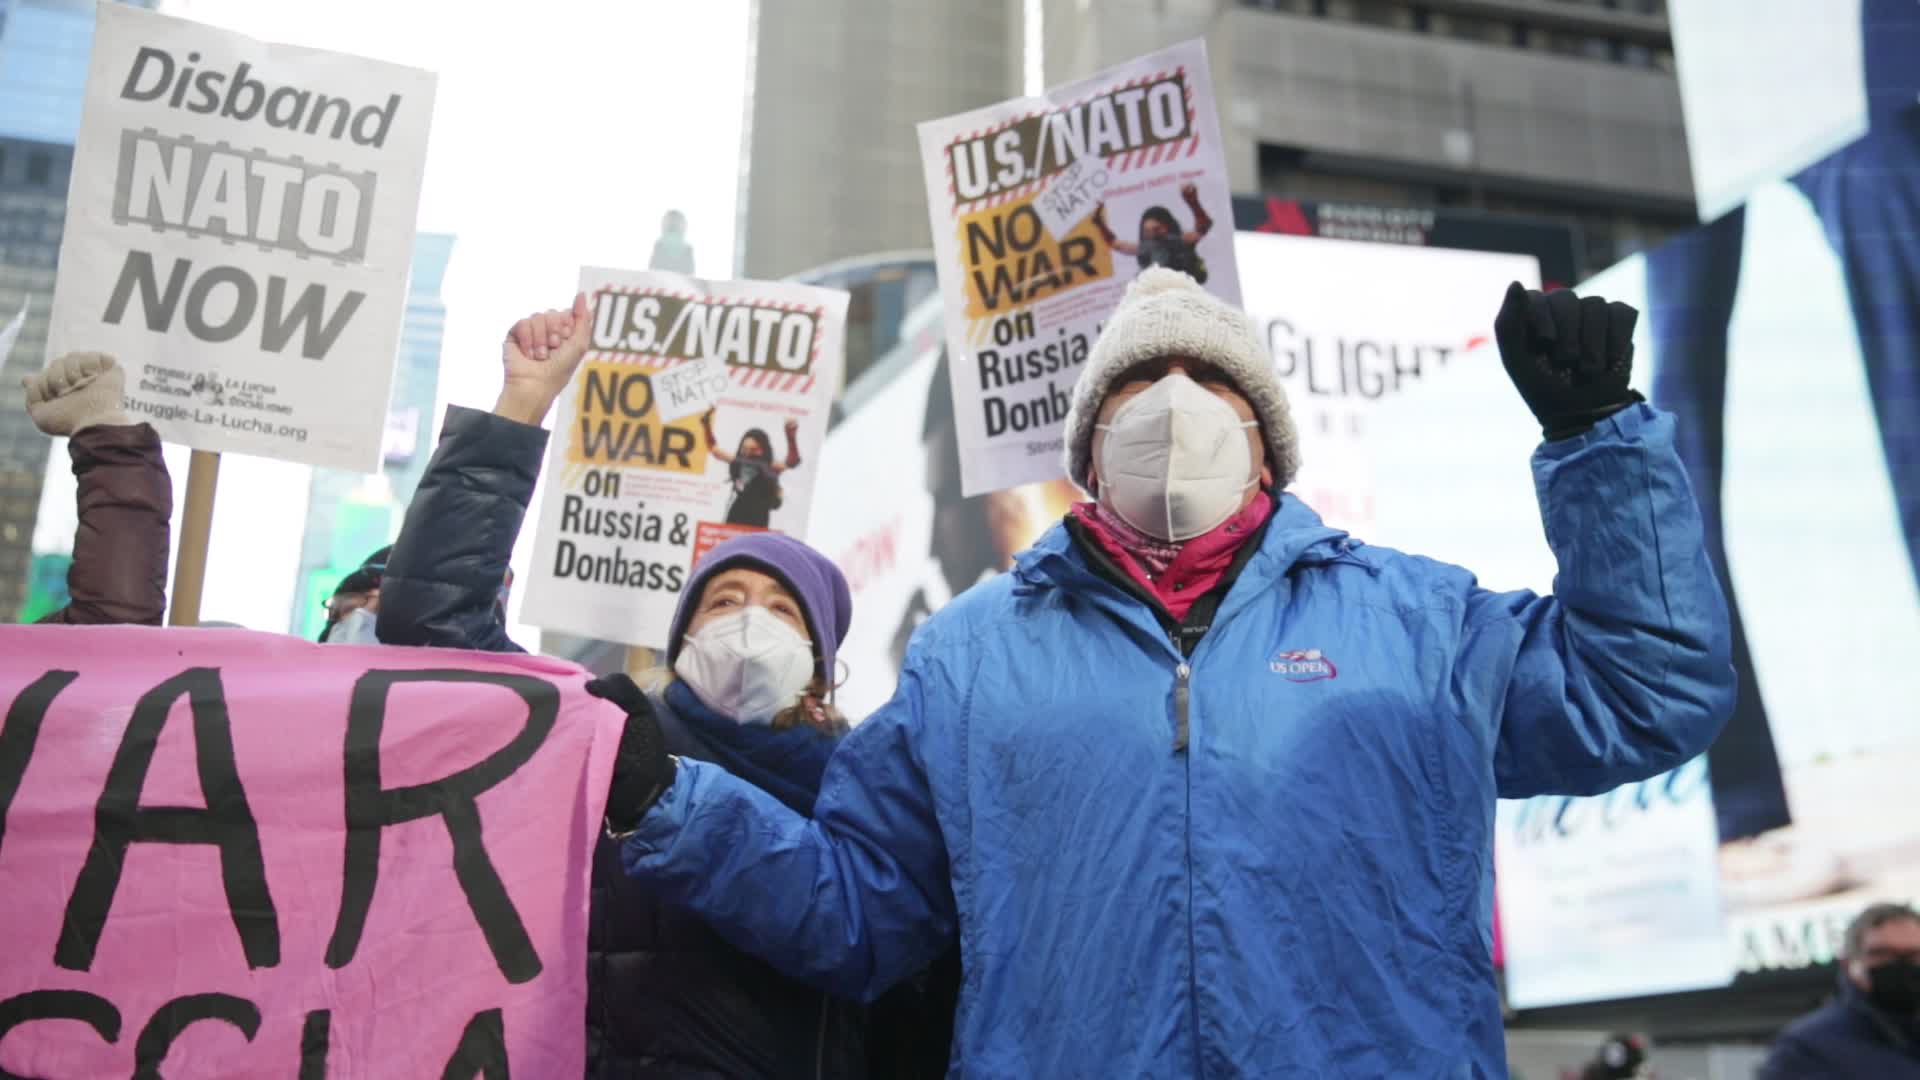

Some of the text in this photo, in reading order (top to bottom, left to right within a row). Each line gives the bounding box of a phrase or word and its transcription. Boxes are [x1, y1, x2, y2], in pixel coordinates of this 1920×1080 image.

[120, 47, 402, 149] Disband
[127, 137, 361, 255] NATO
[966, 203, 1043, 265] NO
[103, 249, 366, 361] NOW
[969, 236, 1098, 312] WAR
[978, 326, 1089, 390] Russia
[993, 311, 1035, 347] on
[1266, 319, 1454, 400] GLIGHT
[583, 370, 654, 418] NO
[983, 381, 1071, 438] Donb
[581, 418, 696, 468] WAR
[584, 469, 620, 499] on
[560, 495, 662, 542] Russia
[668, 512, 690, 547] &
[553, 540, 684, 593] Donbass
[0, 667, 560, 985] AR
